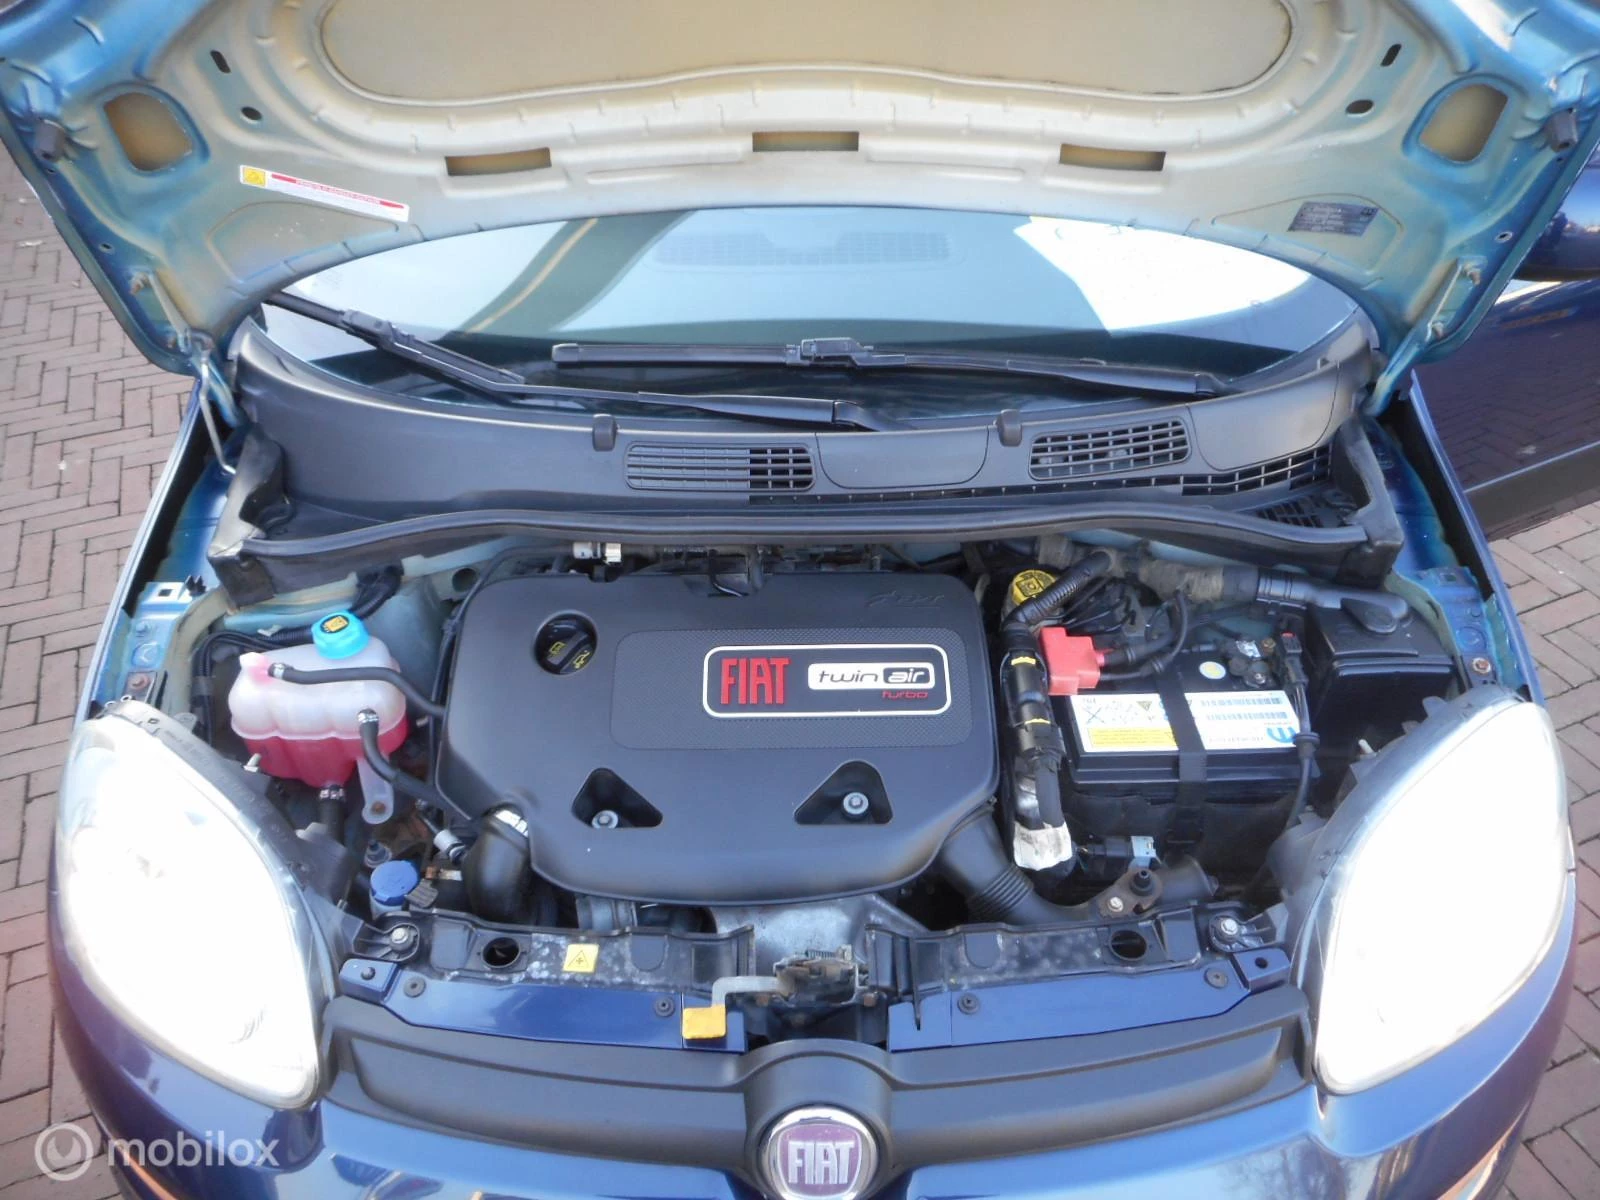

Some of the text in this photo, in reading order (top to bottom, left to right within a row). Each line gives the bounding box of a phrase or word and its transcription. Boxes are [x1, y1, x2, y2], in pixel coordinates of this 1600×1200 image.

[720, 657, 792, 705] FIAT
[881, 690, 928, 700] turbo
[787, 1140, 855, 1185] FIAT
